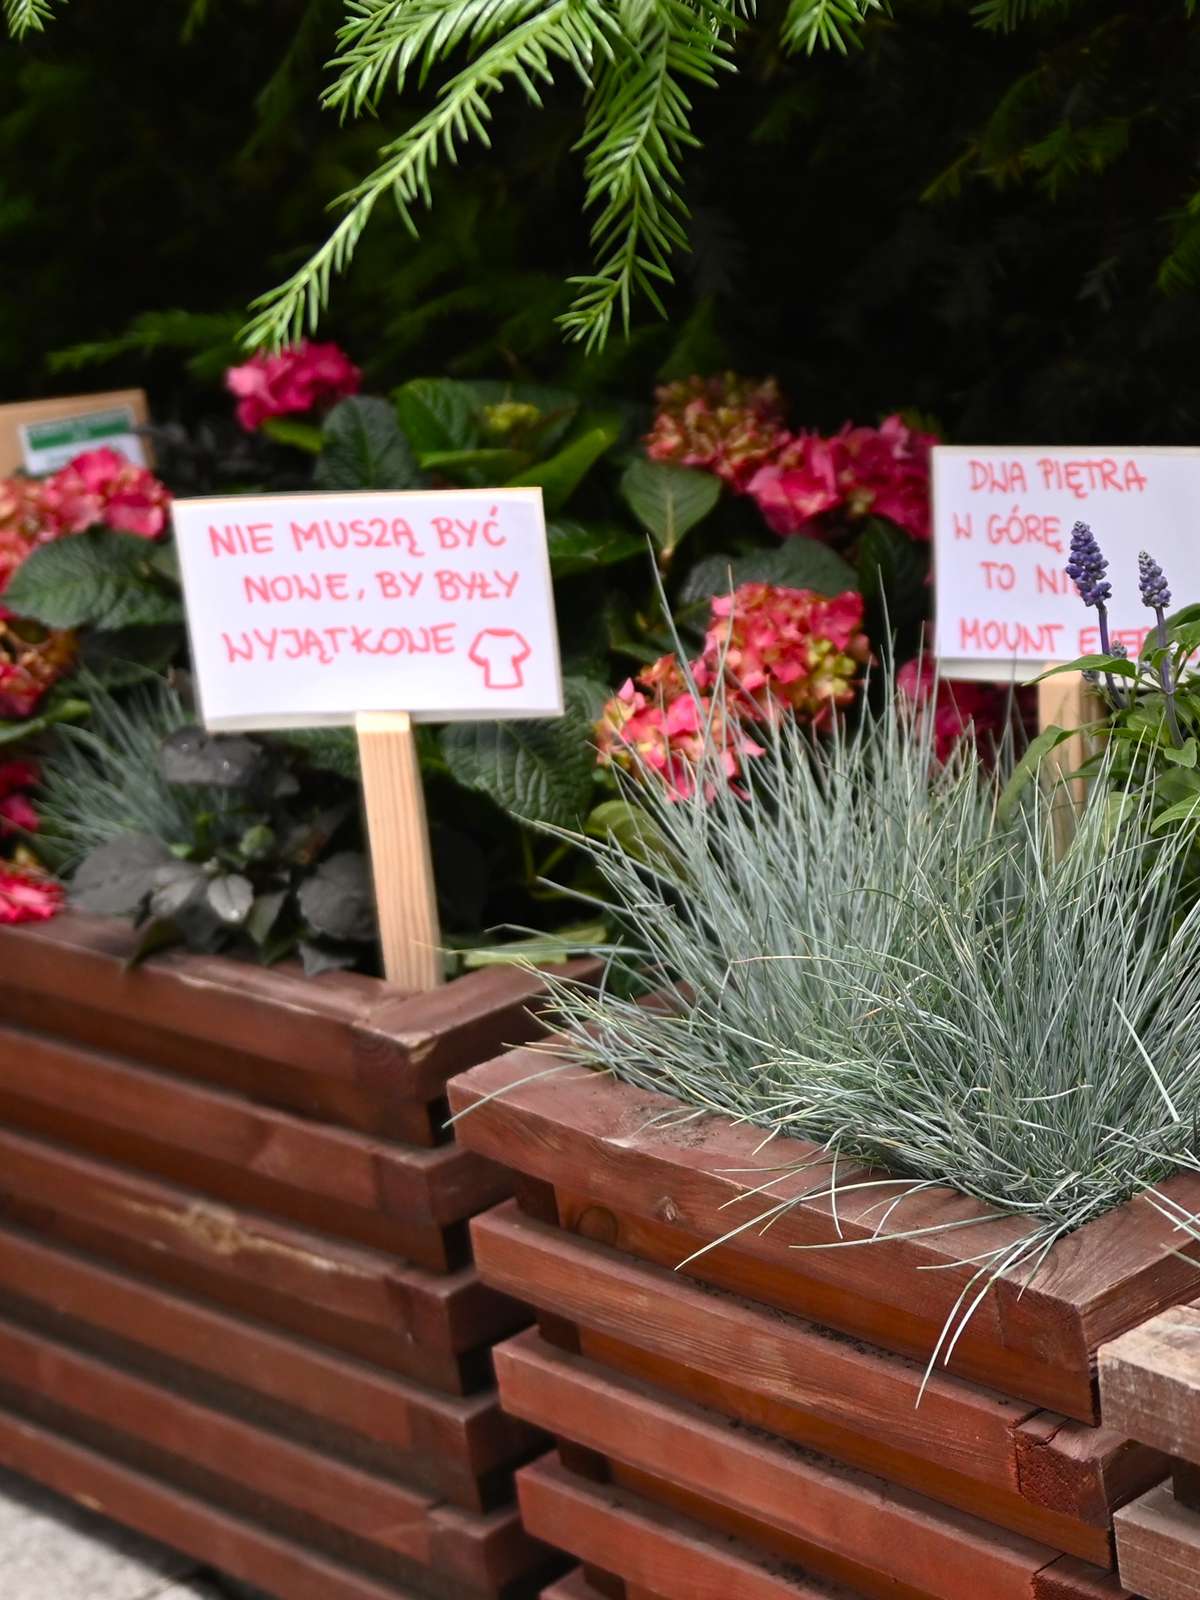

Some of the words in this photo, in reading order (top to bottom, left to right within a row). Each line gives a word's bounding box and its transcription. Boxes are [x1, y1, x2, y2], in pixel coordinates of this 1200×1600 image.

[968, 459, 1028, 493] DWA
[1037, 458, 1147, 499] PIĘTRA
[208, 523, 273, 556] NIE
[290, 518, 425, 556] MUSZĄ
[431, 506, 507, 550] BYĆ
[953, 513, 972, 540] W
[987, 504, 1063, 554] GÓRĘ
[243, 573, 365, 602] NOWE,
[376, 571, 424, 599] BY
[435, 570, 519, 602] BYŁY
[980, 561, 1016, 591] TO
[221, 623, 456, 664] WYJĄTKOWE
[959, 618, 1064, 653] MOUNT
